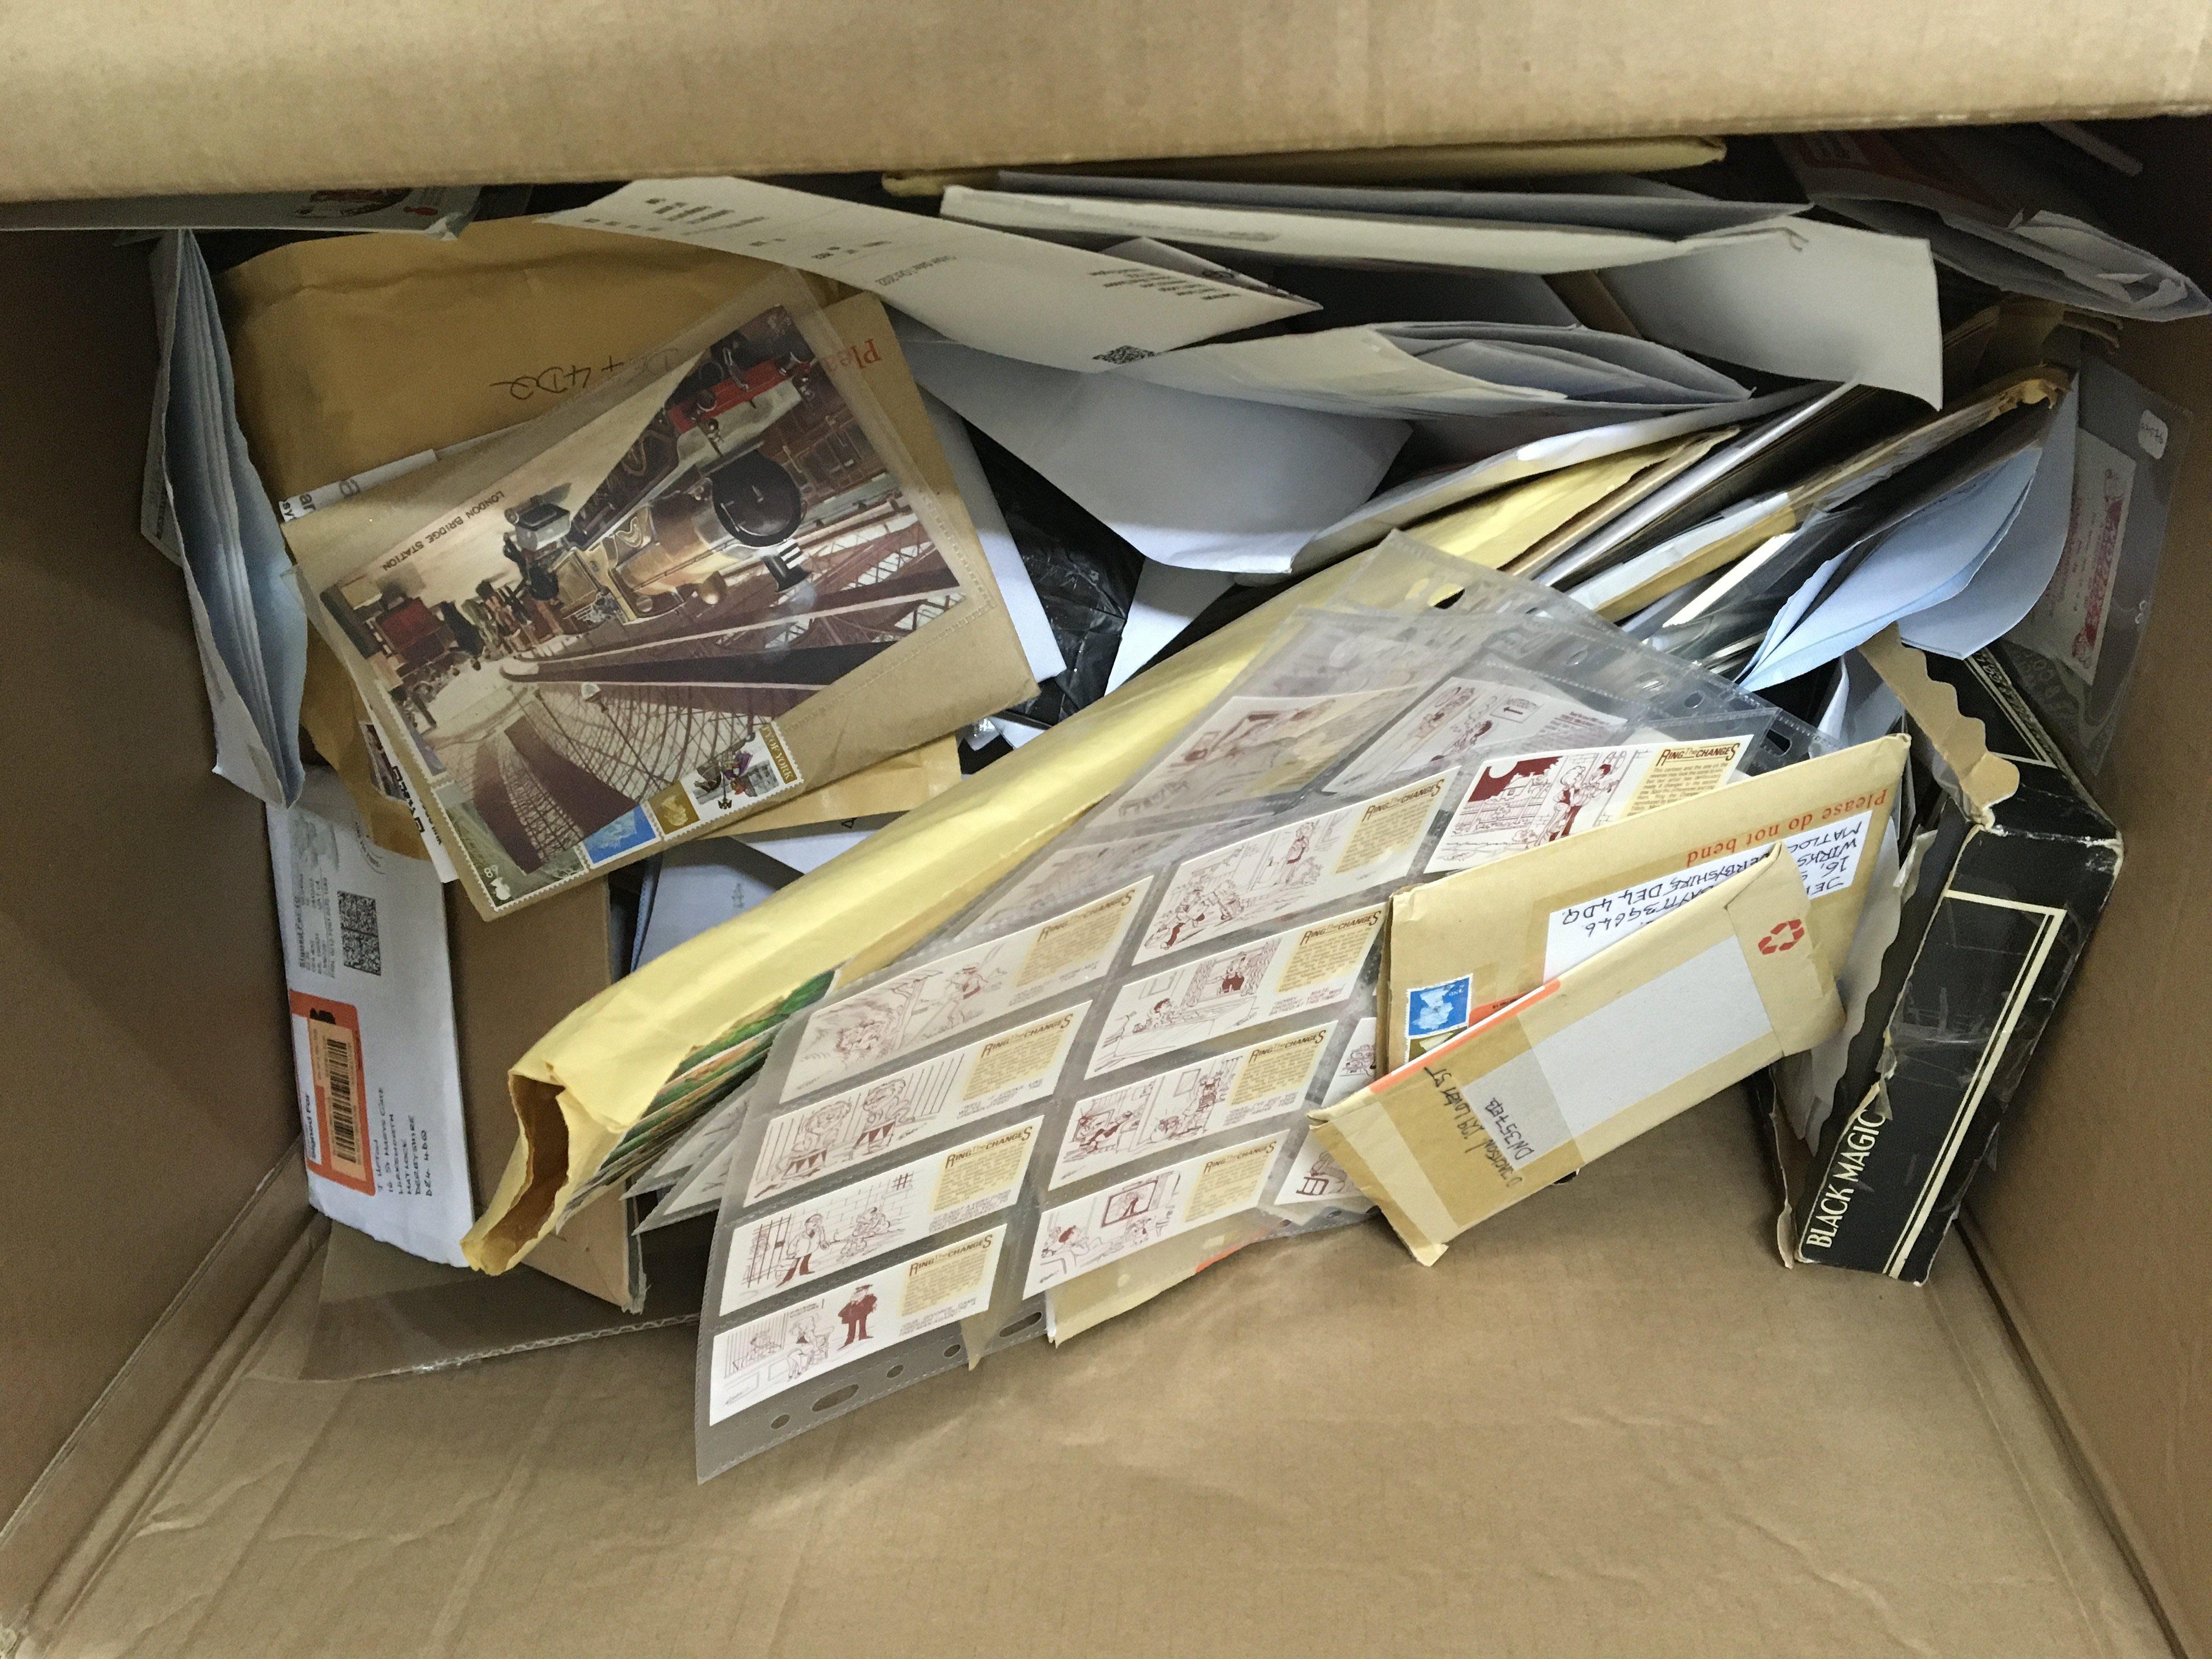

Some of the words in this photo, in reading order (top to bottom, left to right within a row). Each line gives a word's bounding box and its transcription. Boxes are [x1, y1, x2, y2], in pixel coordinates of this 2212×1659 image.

[466, 490, 505, 519] LONDON
[425, 516, 464, 543] BRIDGE
[382, 541, 424, 571] STATION
[775, 752, 793, 780] YORK
[1696, 743, 1740, 761] CHANGES
[1822, 788, 1888, 819] Please
[1746, 824, 1779, 847] not
[1788, 814, 1813, 831] do
[1787, 821, 1862, 854] MATLOC
[1686, 838, 1737, 868] bend
[1797, 838, 1857, 867] WIRKS
[307, 1116, 316, 1159] Signed
[1805, 1183, 1855, 1248] BLACK
[1832, 1108, 1887, 1182] MAGIC
